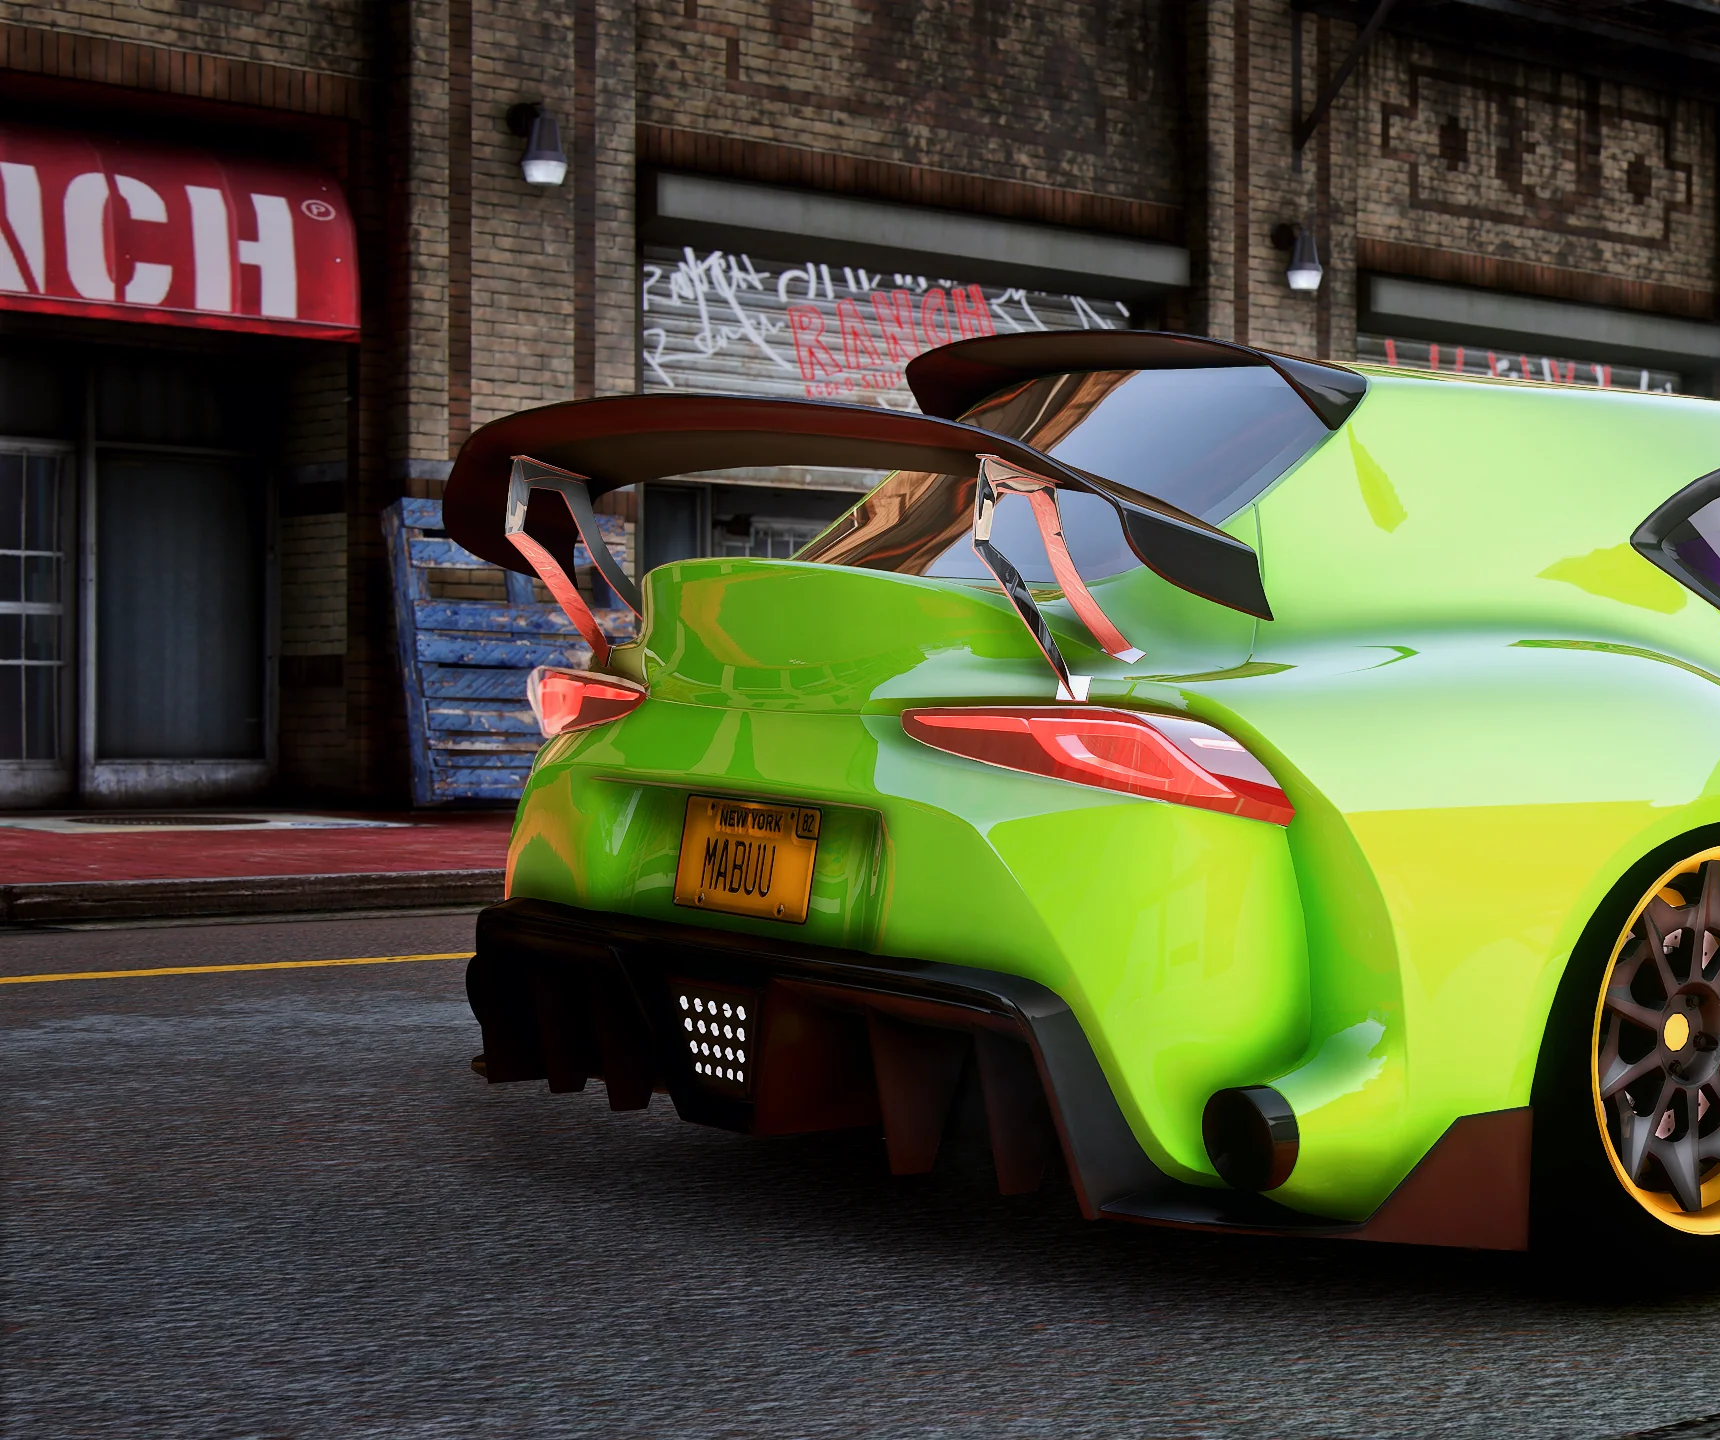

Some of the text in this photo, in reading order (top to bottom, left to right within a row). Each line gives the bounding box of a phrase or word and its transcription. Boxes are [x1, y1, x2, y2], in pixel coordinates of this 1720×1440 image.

[787, 283, 996, 381] RANCH
[719, 808, 783, 833] NEW YORK
[801, 813, 815, 833] 82
[700, 836, 776, 898] MABUU
